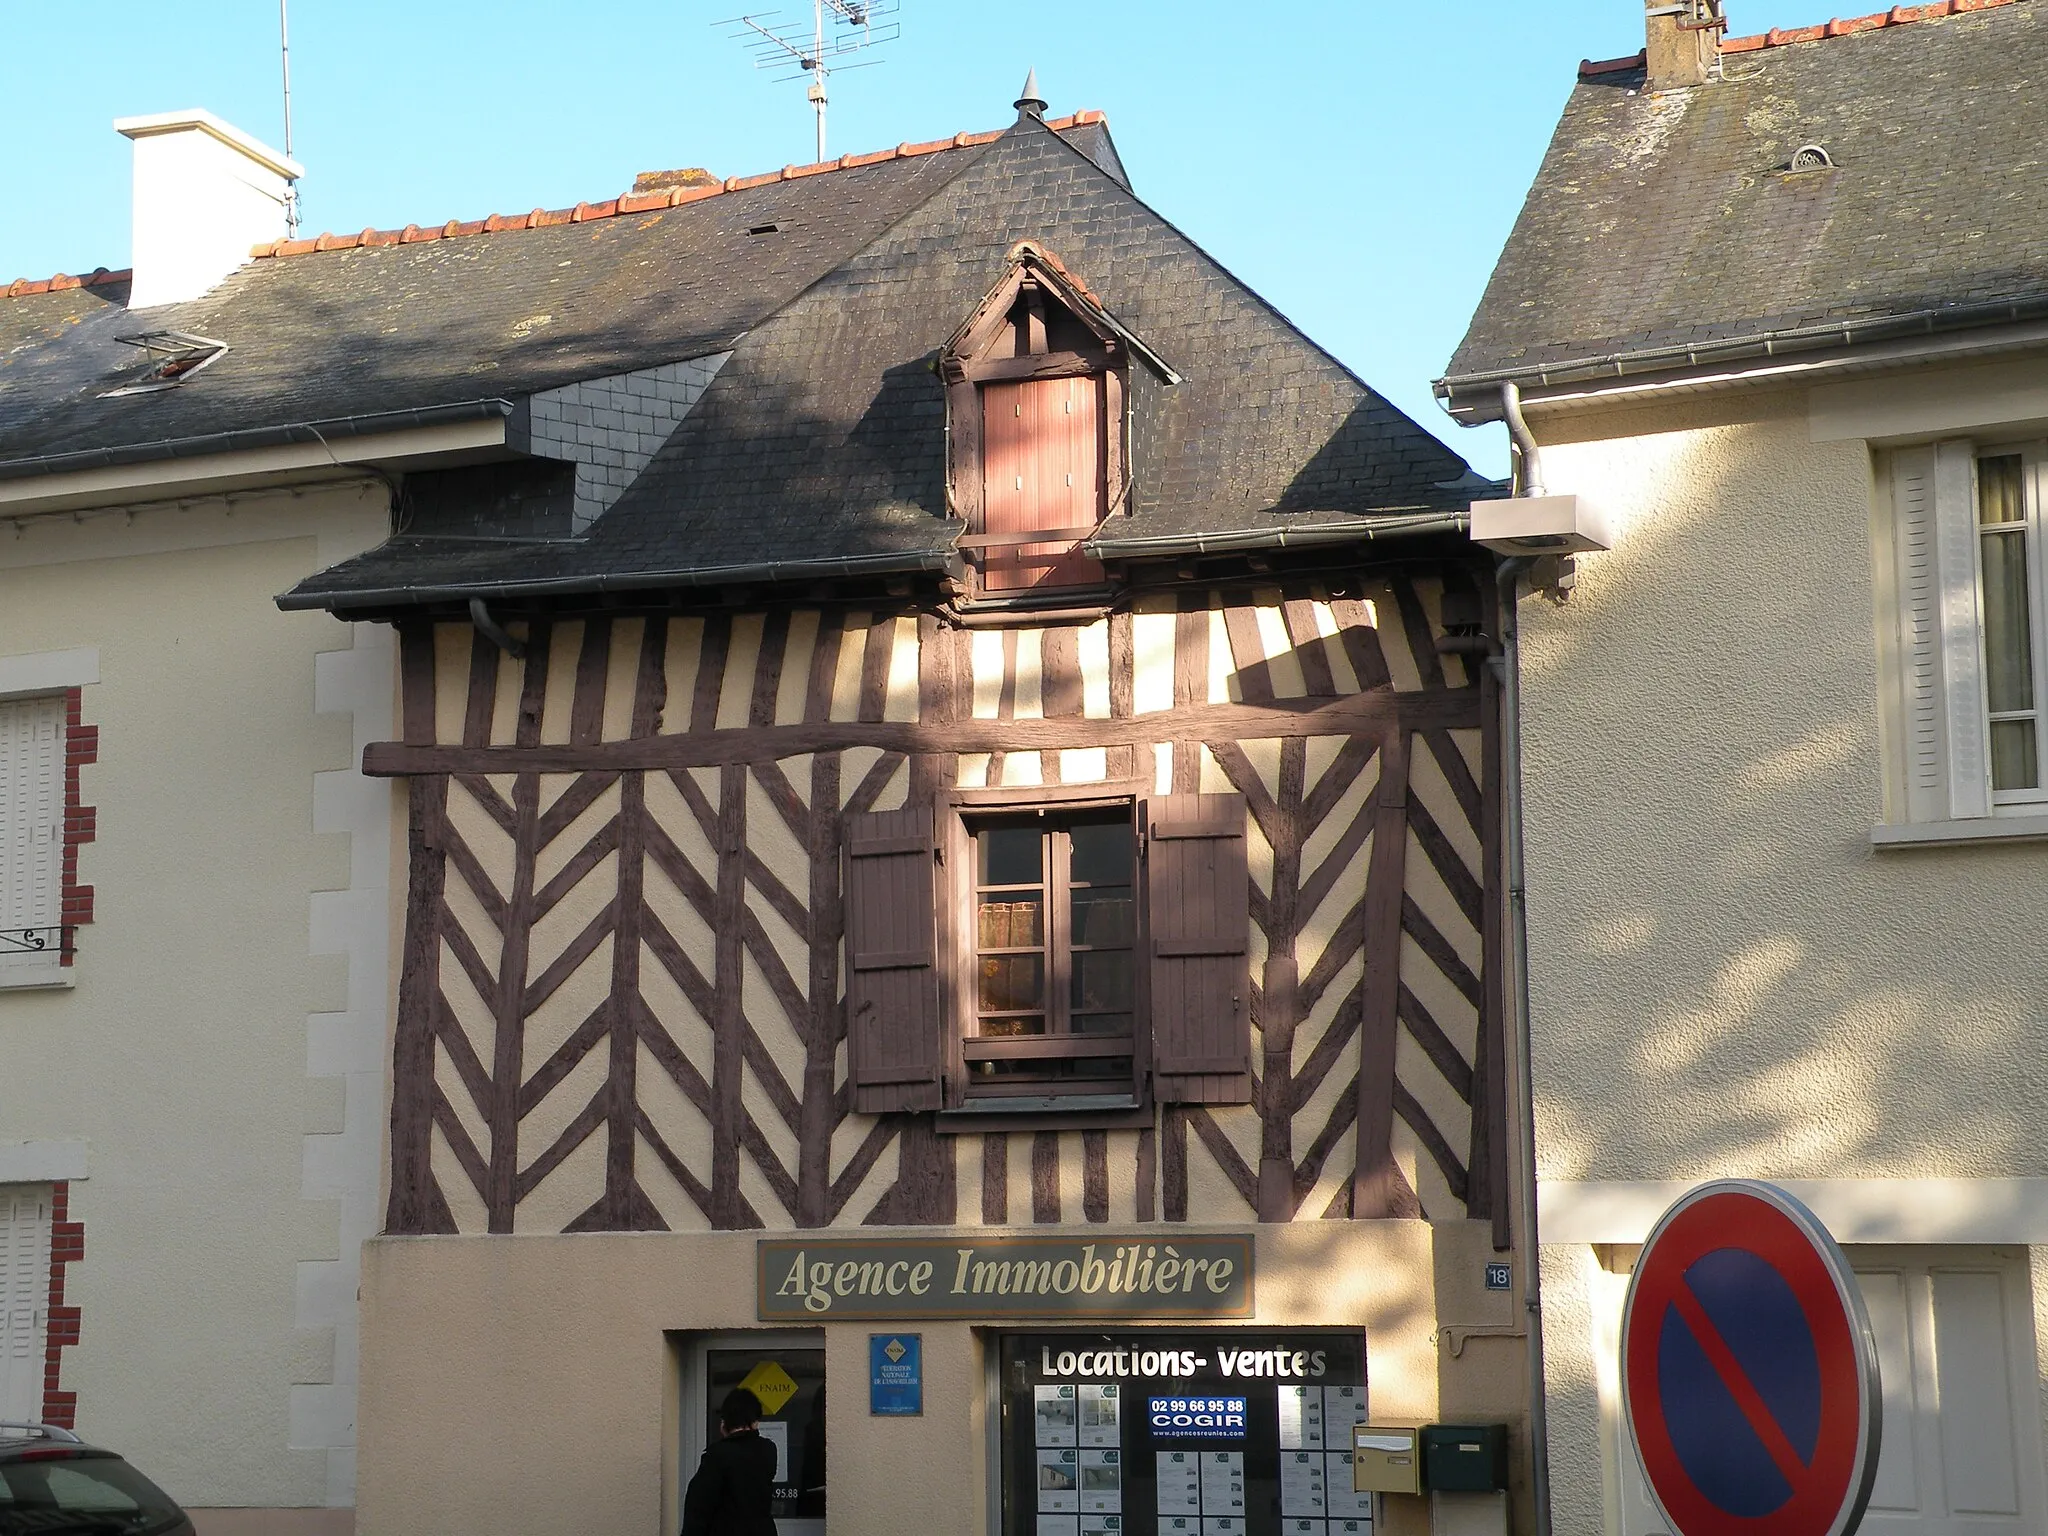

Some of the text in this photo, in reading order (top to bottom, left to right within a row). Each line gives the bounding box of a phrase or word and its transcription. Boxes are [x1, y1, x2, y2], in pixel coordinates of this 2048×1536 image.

[776, 1244, 1234, 1312] Agence Immobilière
[1490, 1269, 1507, 1284] 18
[1216, 1344, 1326, 1377] Ventes
[759, 1384, 791, 1393] FNAIM
[1151, 1400, 1244, 1412] 02 99 66 95 88
[1152, 1414, 1244, 1427] COGIR
[1153, 1430, 1244, 1438] www.agencesreunies.com
